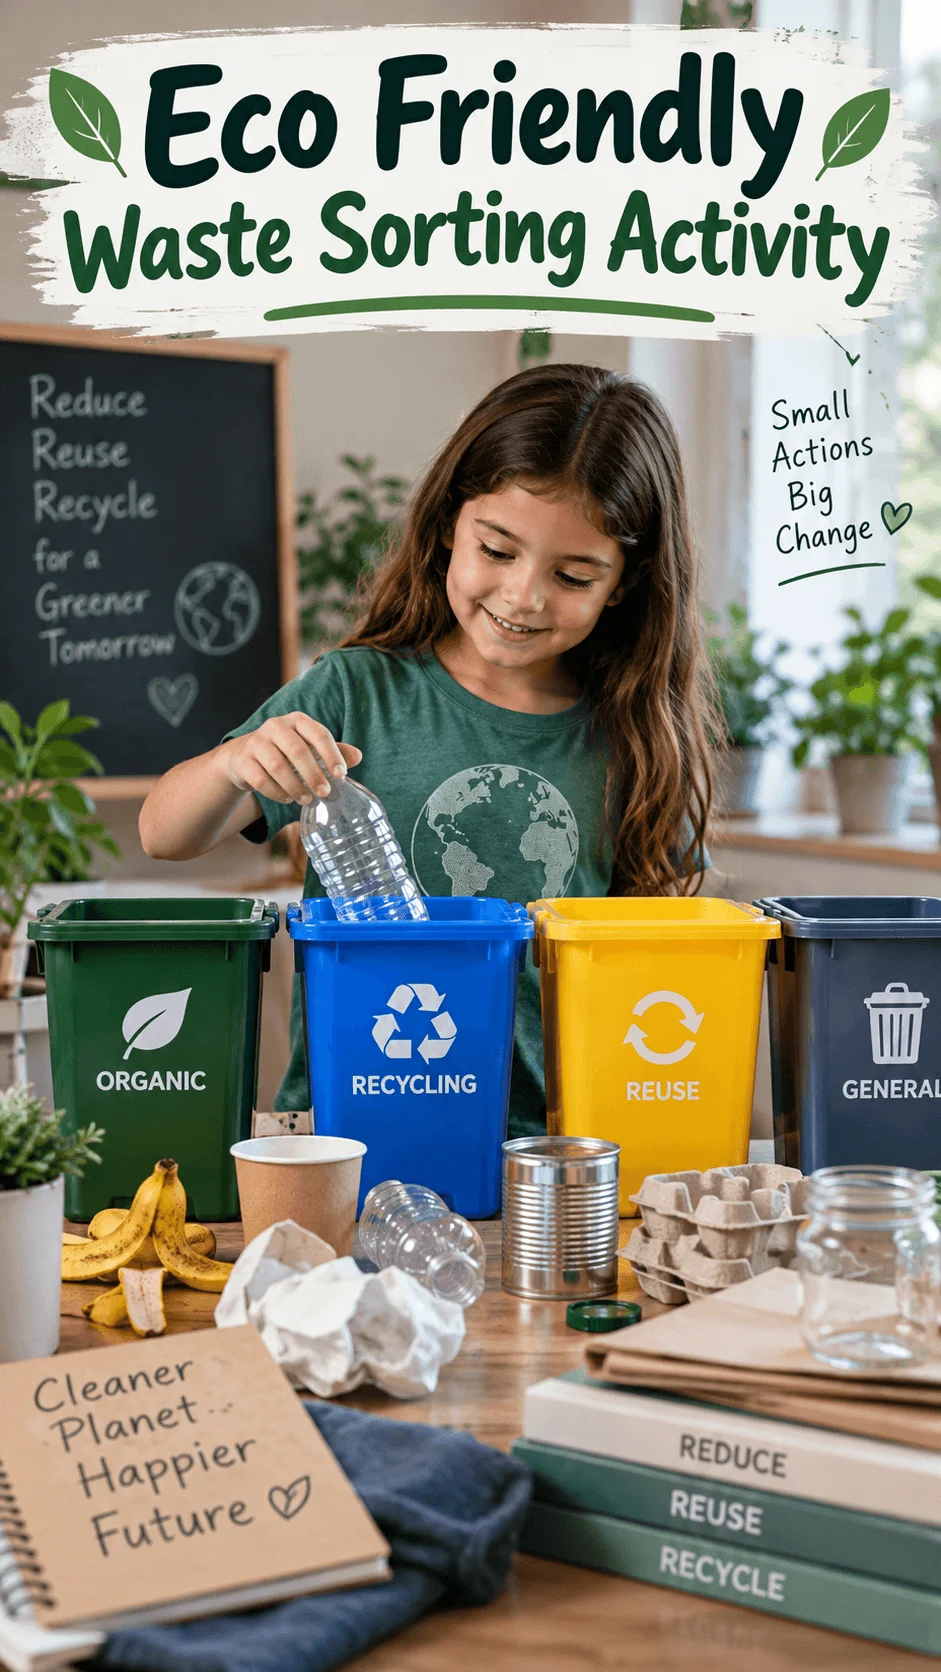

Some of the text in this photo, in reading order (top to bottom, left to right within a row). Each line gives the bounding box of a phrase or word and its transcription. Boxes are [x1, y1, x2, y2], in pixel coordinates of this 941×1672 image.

[30, 373, 147, 418] Reduce
[31, 427, 130, 471] Reuse
[33, 478, 158, 534] Recycle
[33, 538, 101, 574] for a
[35, 582, 151, 622] Greener
[38, 627, 176, 666] Tomorrow
[96, 1070, 206, 1091] ORGANIC
[351, 1073, 477, 1095] RECYCLING
[626, 1081, 700, 1102] REUSE
[842, 1079, 941, 1099] GENERAL
[34, 1361, 194, 1412] Cleaner
[50, 1396, 199, 1453] Planet
[77, 1439, 257, 1498] Happier
[680, 1433, 788, 1479] REDUCE
[90, 1500, 255, 1557] Future
[670, 1489, 763, 1536] REUSE
[660, 1545, 786, 1601] RECYCLE
